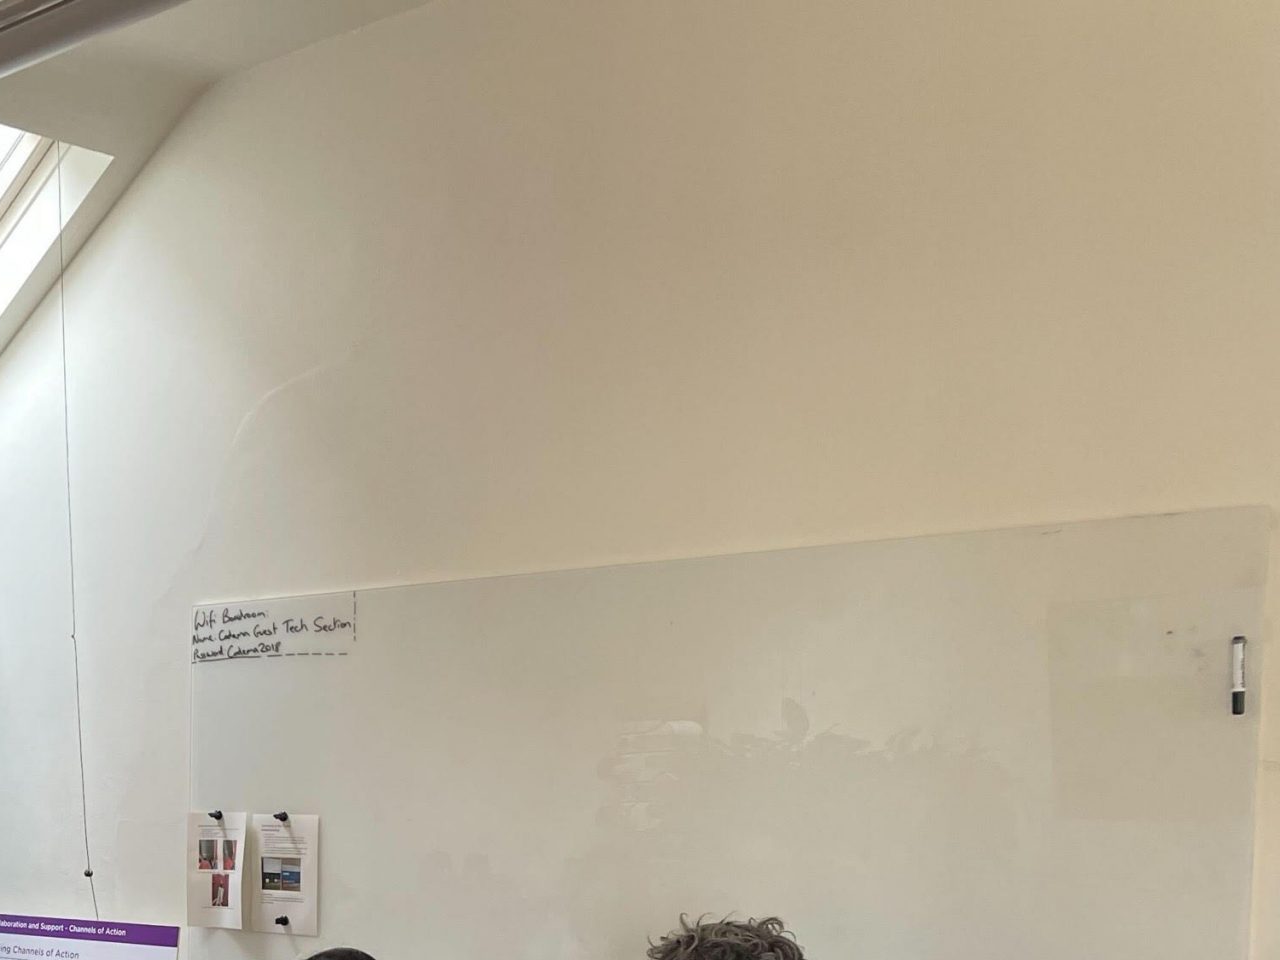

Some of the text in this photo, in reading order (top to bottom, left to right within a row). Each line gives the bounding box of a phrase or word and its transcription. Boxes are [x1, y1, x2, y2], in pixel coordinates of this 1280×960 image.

[253, 623, 277, 639] Guest
[283, 619, 308, 633] Tech
[314, 616, 352, 633] Section
[40, 923, 64, 932] Support
[69, 925, 96, 934] Channels
[98, 926, 104, 934] of
[105, 928, 126, 936] Action
[13, 946, 44, 956] Channels
[46, 948, 54, 957] of
[55, 950, 80, 959] Action
